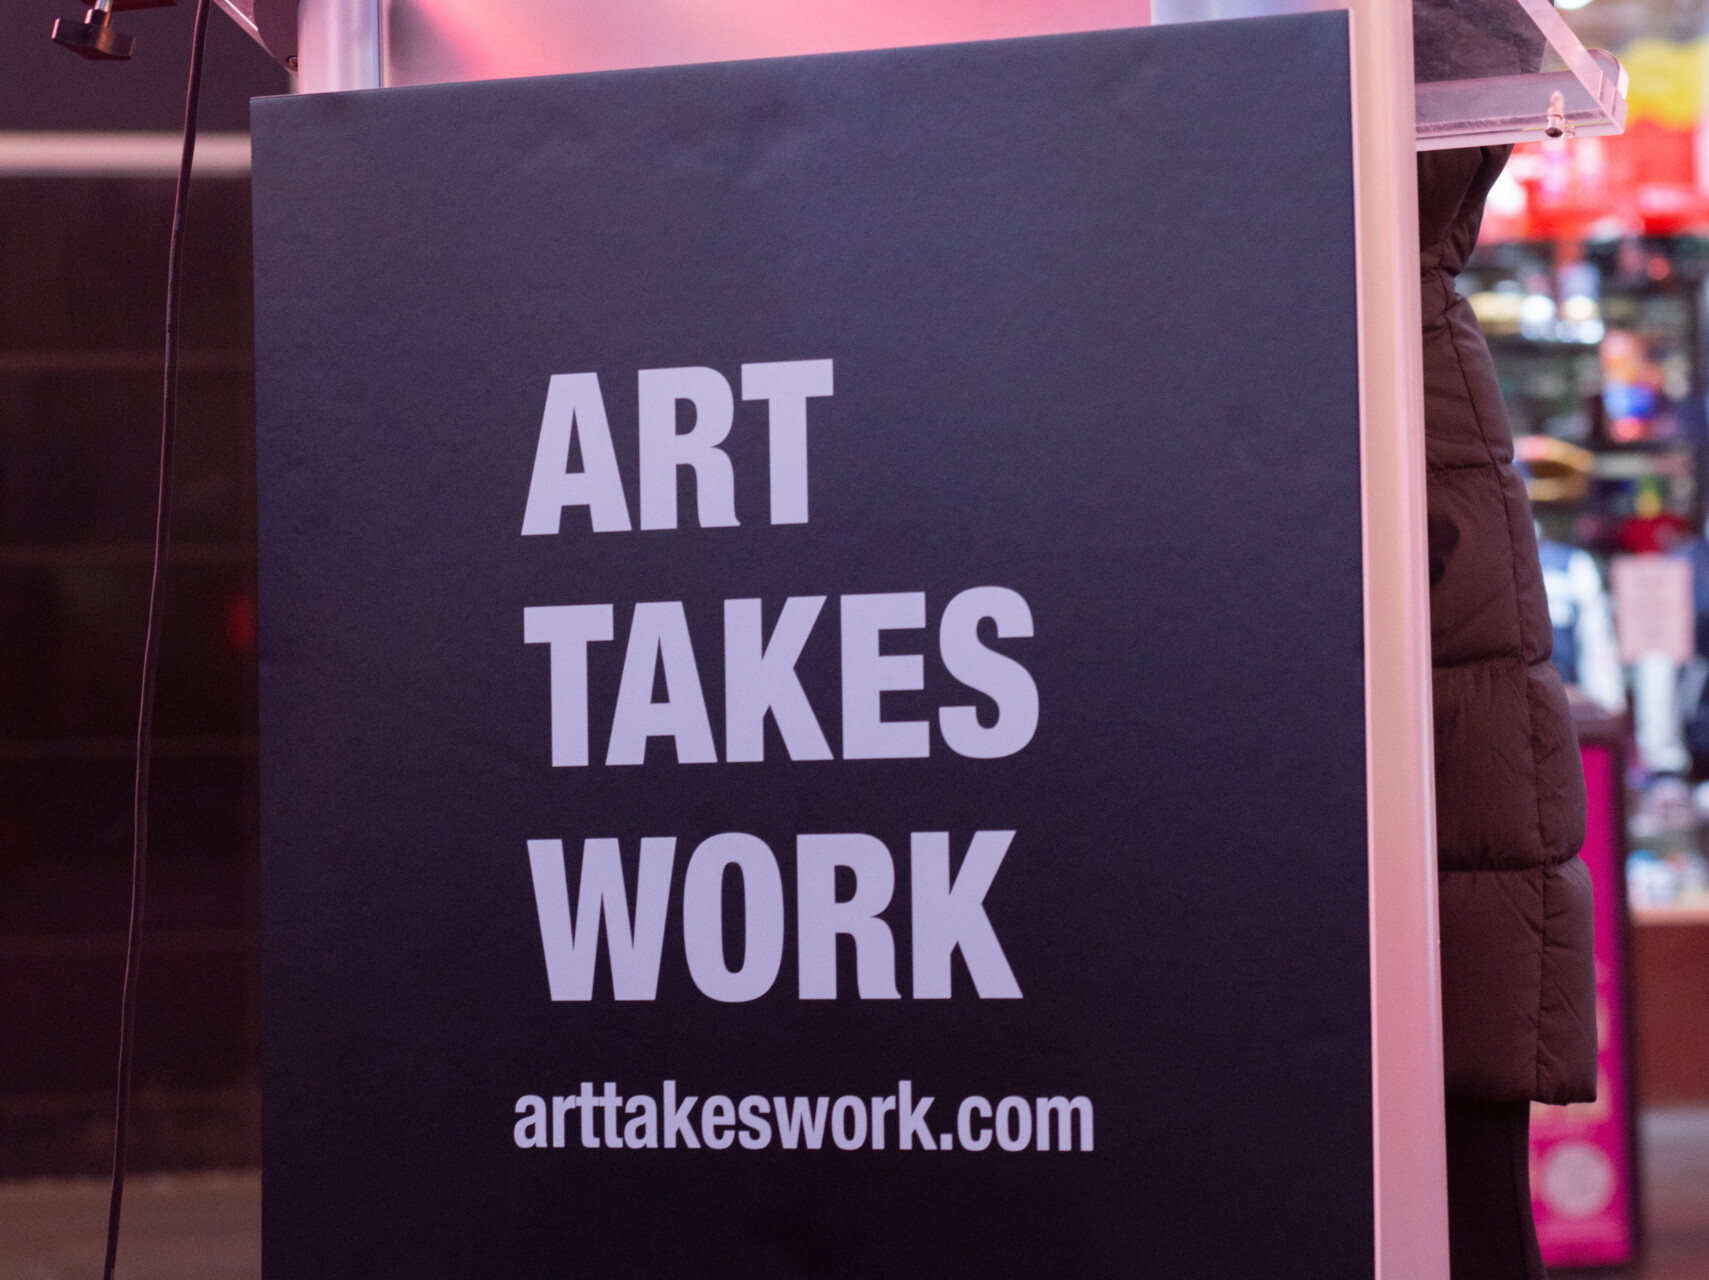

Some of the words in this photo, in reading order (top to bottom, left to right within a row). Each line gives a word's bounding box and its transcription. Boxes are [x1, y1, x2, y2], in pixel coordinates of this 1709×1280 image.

[521, 359, 835, 536] ART
[524, 586, 1040, 767] TAKES
[526, 829, 1023, 1003] WORK
[513, 1079, 1095, 1152] arttakeswork.com
